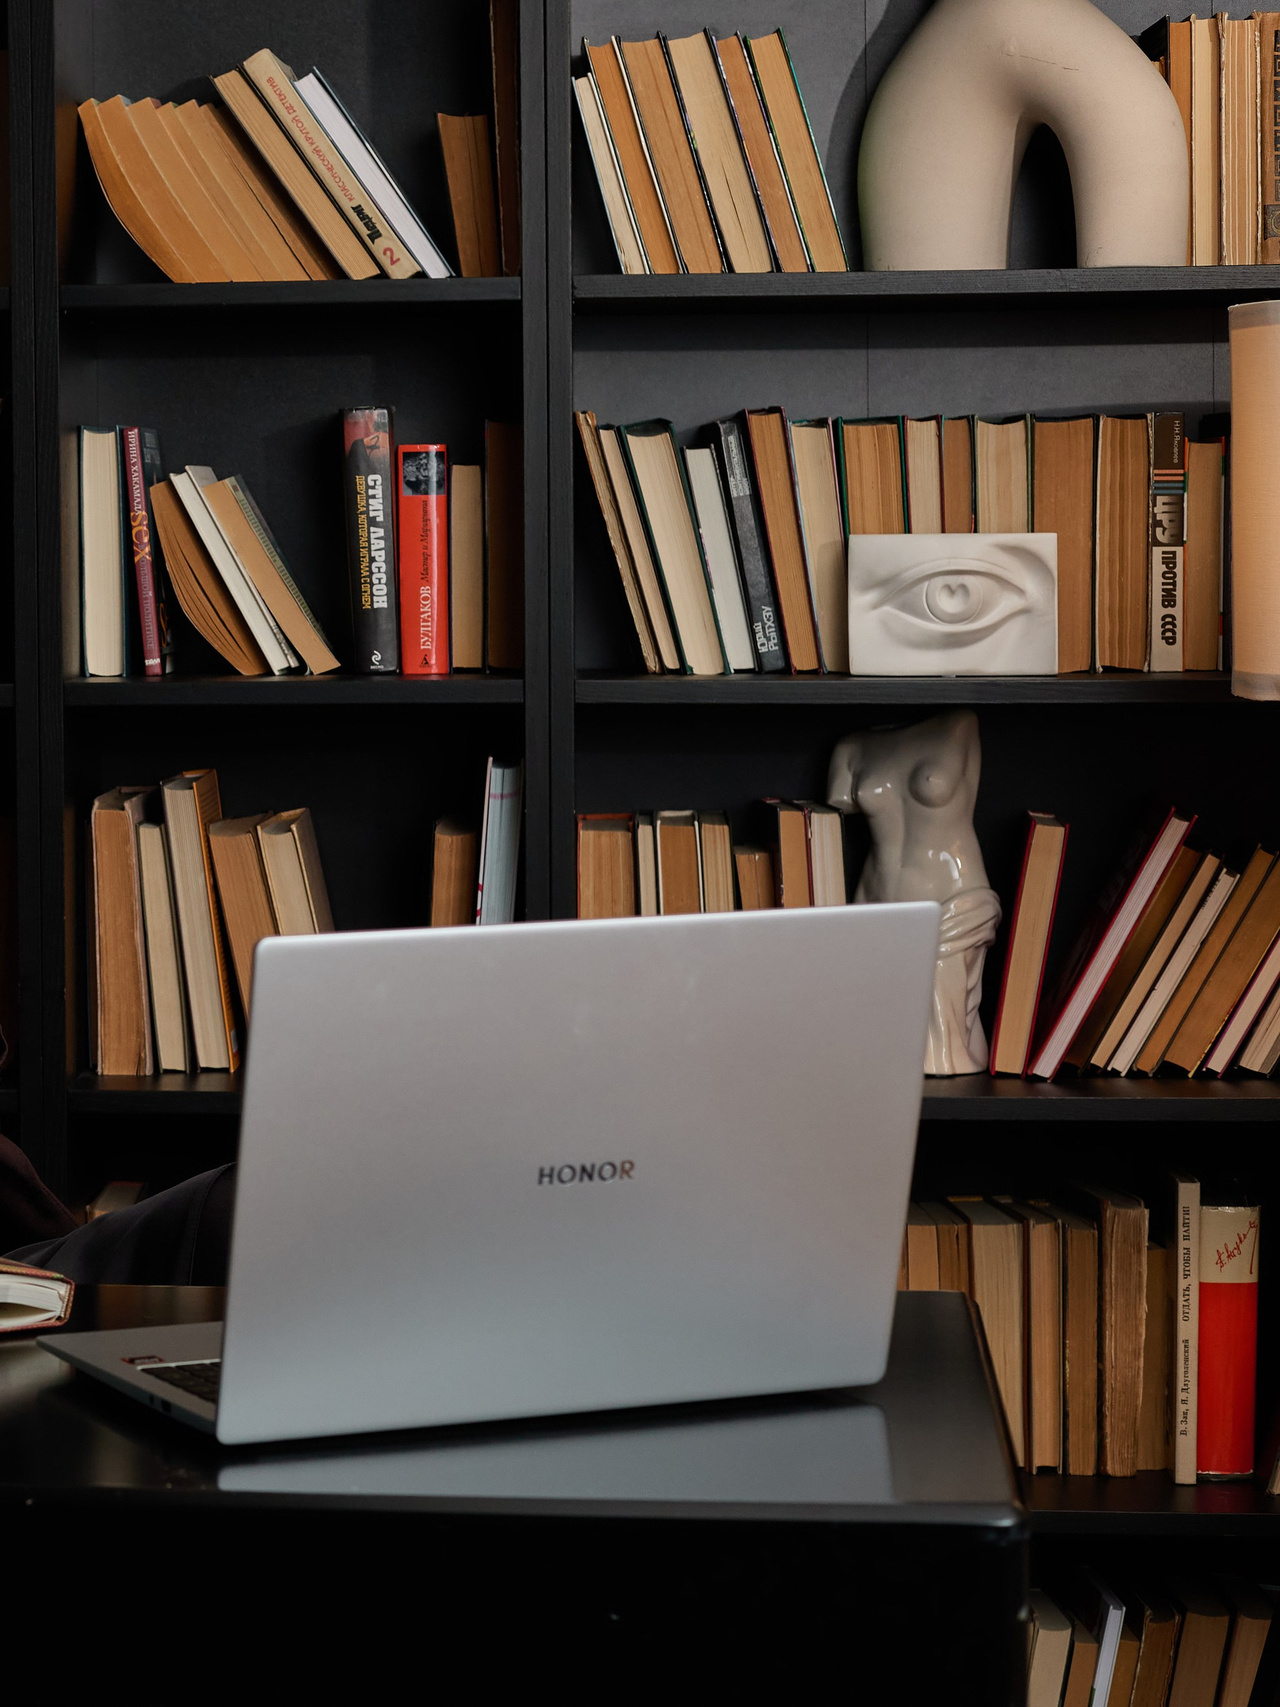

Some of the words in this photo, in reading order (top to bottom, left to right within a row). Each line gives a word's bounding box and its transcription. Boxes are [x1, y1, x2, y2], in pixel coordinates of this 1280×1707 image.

[266, 76, 296, 115] ДЕТЕКТИВ
[383, 247, 401, 266] 2
[127, 430, 138, 463] ИРИНА
[131, 464, 143, 515] ХАКАМАДА
[356, 475, 366, 513] ДЕВУШКА,
[367, 473, 382, 521] СТИГ
[358, 514, 368, 547] КОТОРАЯ
[1155, 495, 1179, 544] ЦРУ
[360, 548, 369, 576] ИГРАЛА
[370, 526, 387, 608] ЛАРССОН
[420, 551, 429, 582] Мастер
[361, 583, 371, 608] ОГНЕМ
[1160, 550, 1178, 608] ПРОТИВ
[419, 585, 431, 649] БУЛГАКОВ
[1160, 613, 1178, 645] СССР
[537, 1159, 636, 1185] HONOR
[1182, 1206, 1191, 1241] НАЙТИ!
[1183, 1247, 1191, 1278] ЧТОБЫ
[1182, 1283, 1191, 1321] ОТДАТЬ,
[1180, 1408, 1189, 1425] Зак,
[1181, 1396, 1189, 1404] Я.
[1180, 1427, 1188, 1436] В.
